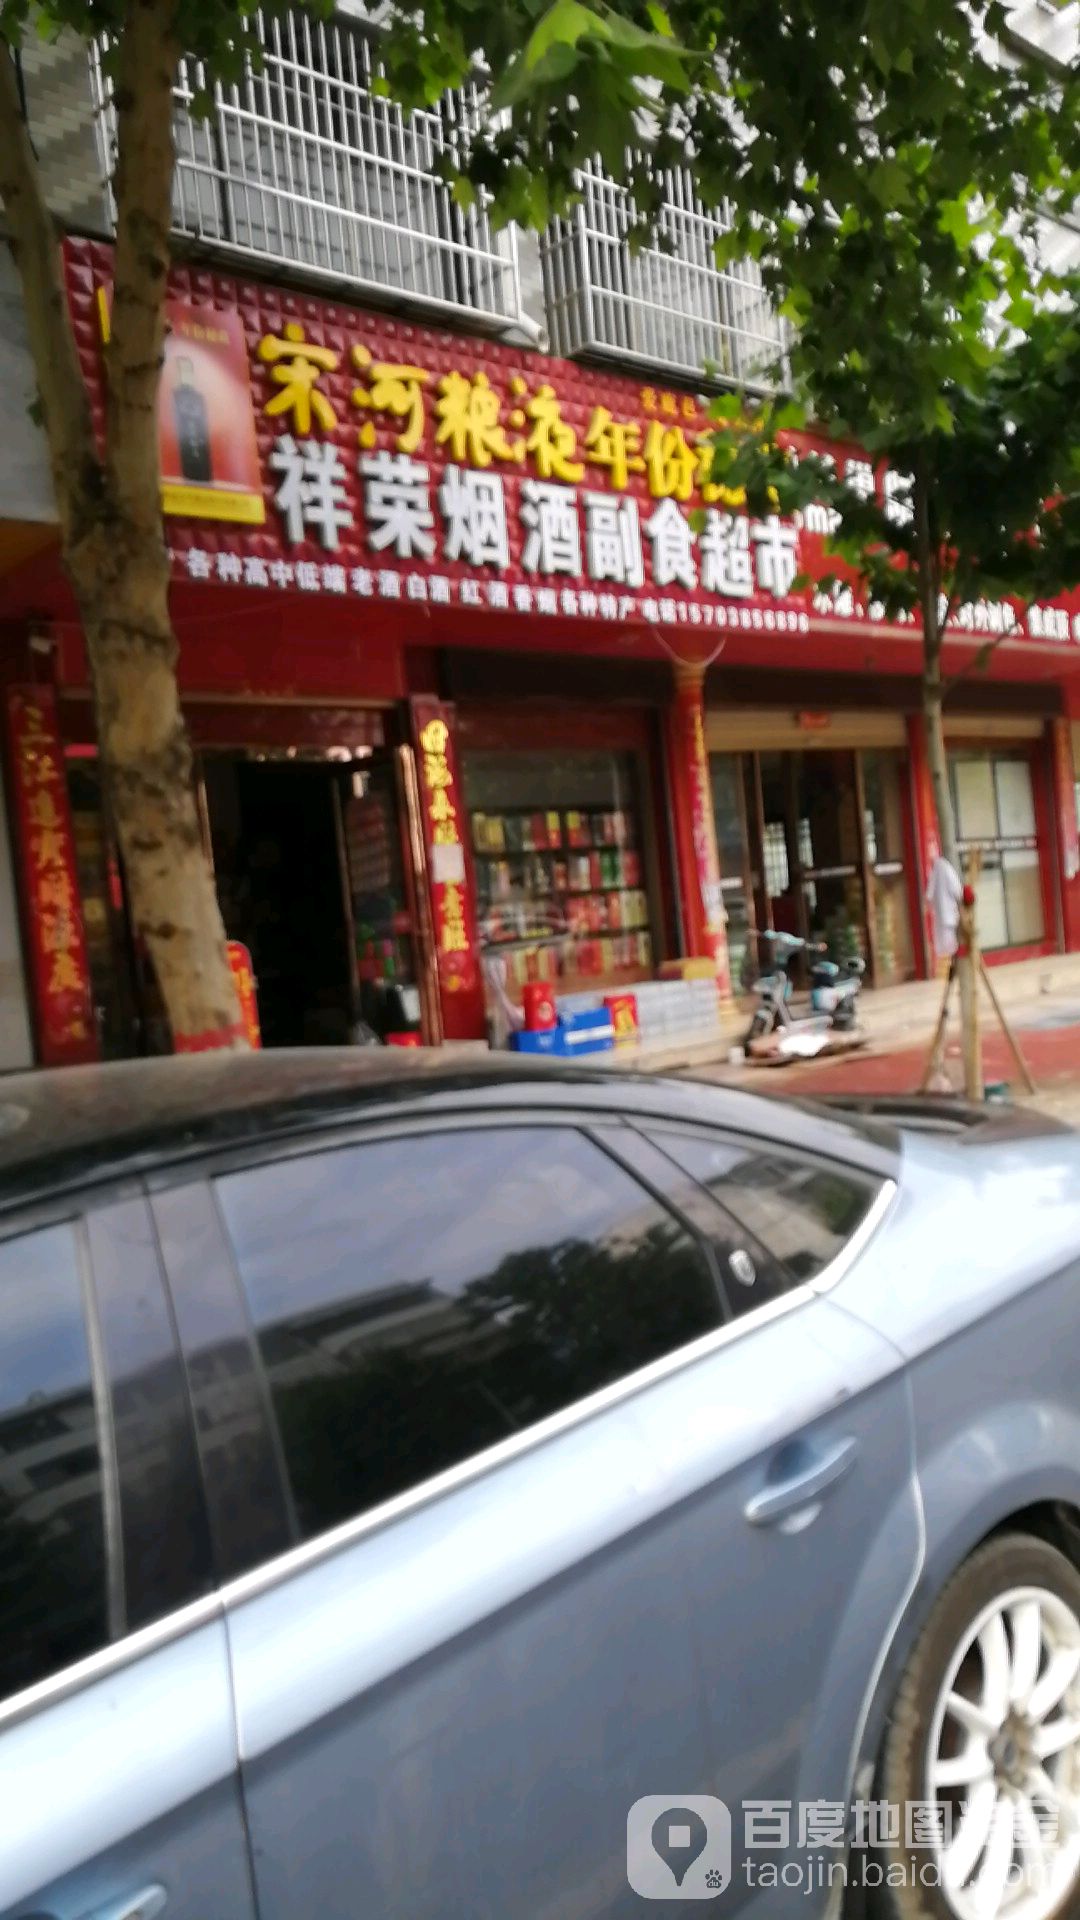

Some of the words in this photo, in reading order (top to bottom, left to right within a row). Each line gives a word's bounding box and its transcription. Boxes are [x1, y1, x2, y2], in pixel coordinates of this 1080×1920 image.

[258, 323, 782, 514] 宋河粮液年份
[269, 433, 799, 599] 祥荣烟酒副食超市
